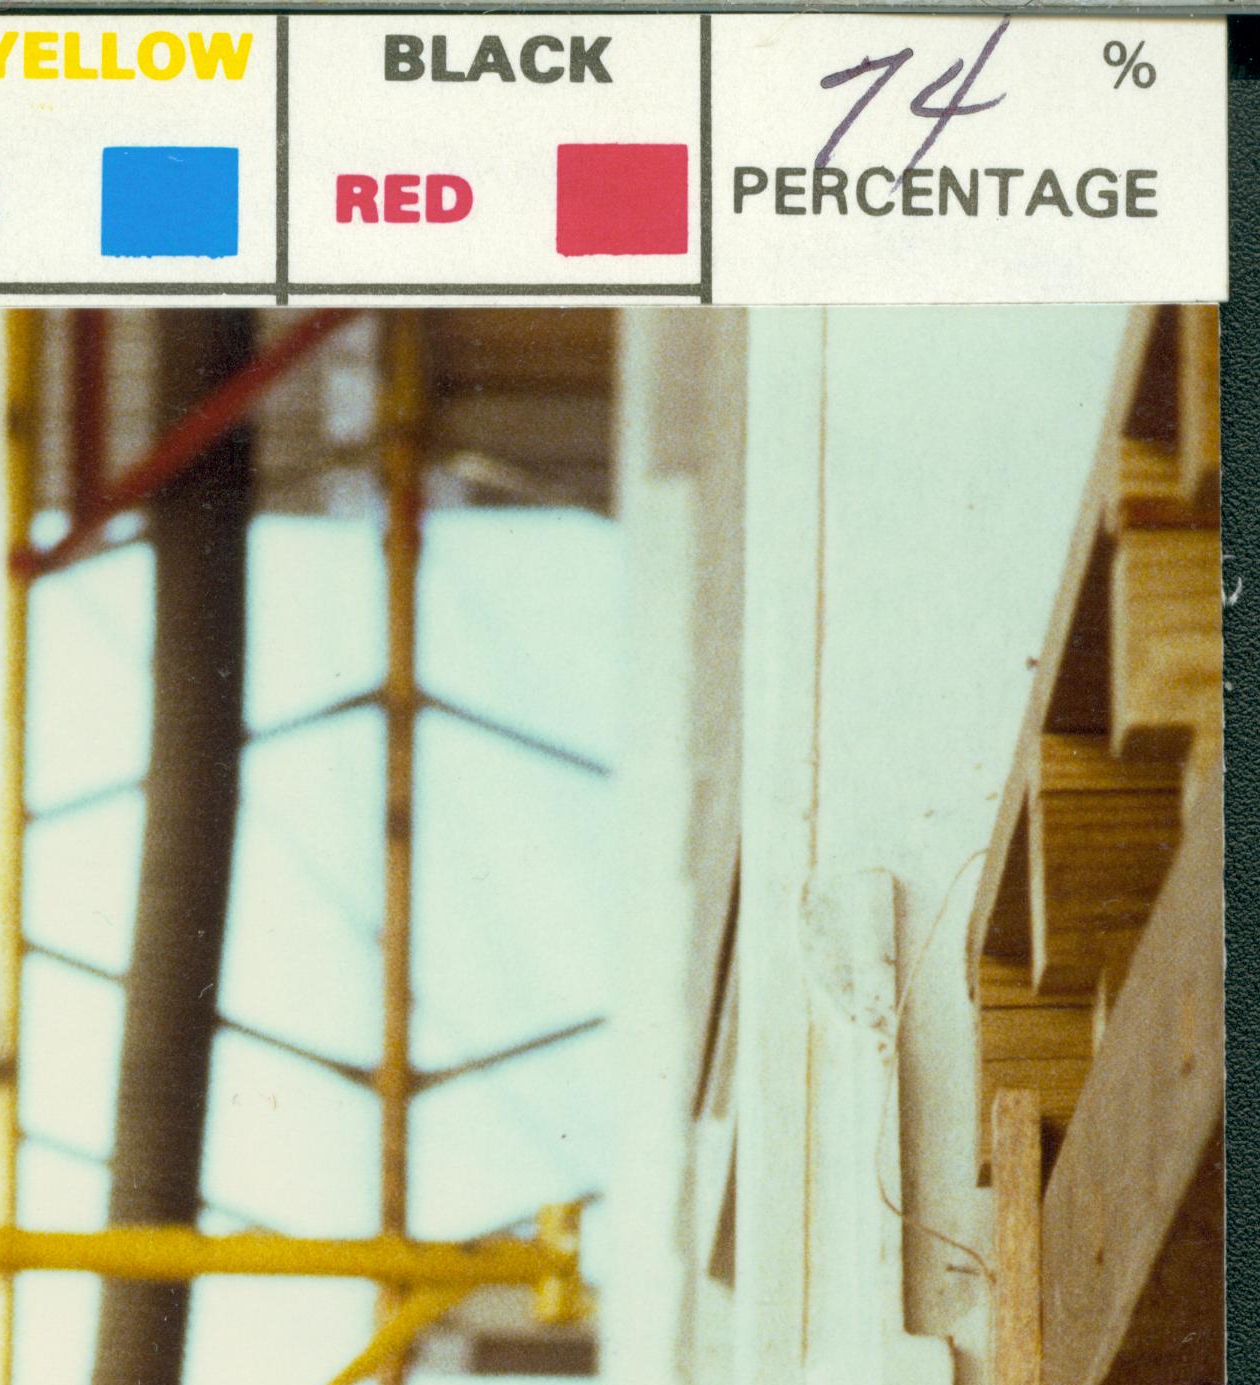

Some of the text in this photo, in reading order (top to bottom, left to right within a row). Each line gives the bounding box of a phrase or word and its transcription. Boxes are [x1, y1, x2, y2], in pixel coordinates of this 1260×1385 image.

[383, 33, 614, 85] BLACK
[1102, 39, 1157, 90] %
[814, 15, 1011, 195] 74
[335, 173, 474, 224] RED
[732, 165, 1159, 218] PERCENTAGE
